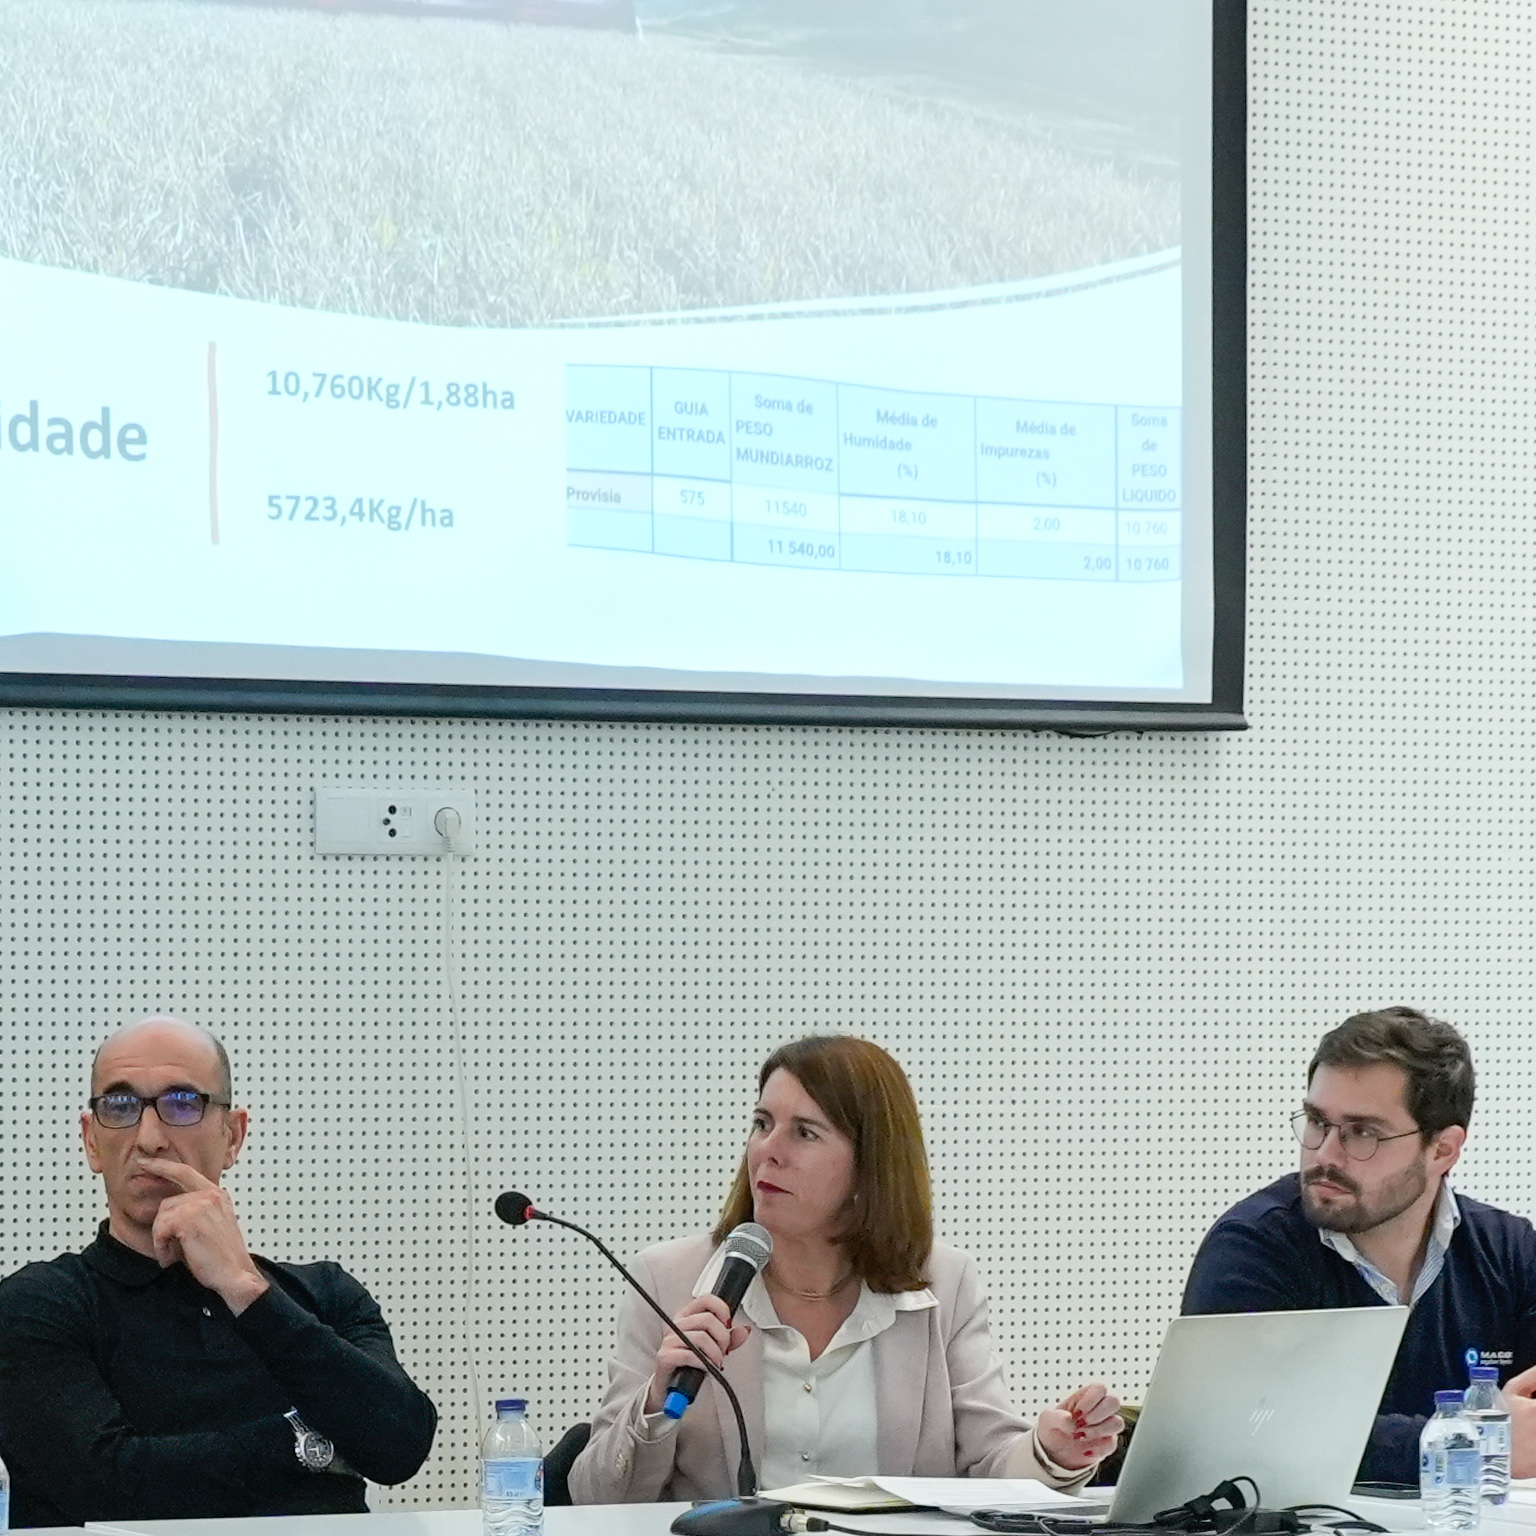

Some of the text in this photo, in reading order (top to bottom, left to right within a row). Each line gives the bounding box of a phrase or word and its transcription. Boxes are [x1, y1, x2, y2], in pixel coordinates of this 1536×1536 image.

[265, 368, 517, 412] 10,760Kg/1,88ha
[673, 400, 709, 416] GUIA
[753, 394, 814, 415] Soma de
[565, 409, 647, 426] VARIEDADE
[875, 408, 938, 428] Média de
[1130, 412, 1168, 428] Soma
[657, 426, 726, 445] ENTRADA
[735, 419, 774, 436] PESO
[1015, 420, 1077, 437] Média de
[843, 432, 912, 452] Humidade
[1141, 438, 1158, 452] de
[736, 447, 835, 472] MUNDIARROZ
[980, 443, 1051, 461] Impurezas
[897, 463, 919, 480] (%)
[1131, 463, 1168, 477] PESO
[1036, 471, 1057, 488] (%)
[566, 486, 622, 504] Provisia
[679, 488, 706, 506] 575
[265, 493, 456, 531] 5723,4Kg/ha
[765, 499, 808, 517] 11540
[1124, 521, 1169, 535] 10 760
[767, 538, 836, 559] 11 540,00
[935, 550, 973, 567] 18,10
[1083, 556, 1112, 572] 2,00
[1127, 557, 1170, 571] 10 760
